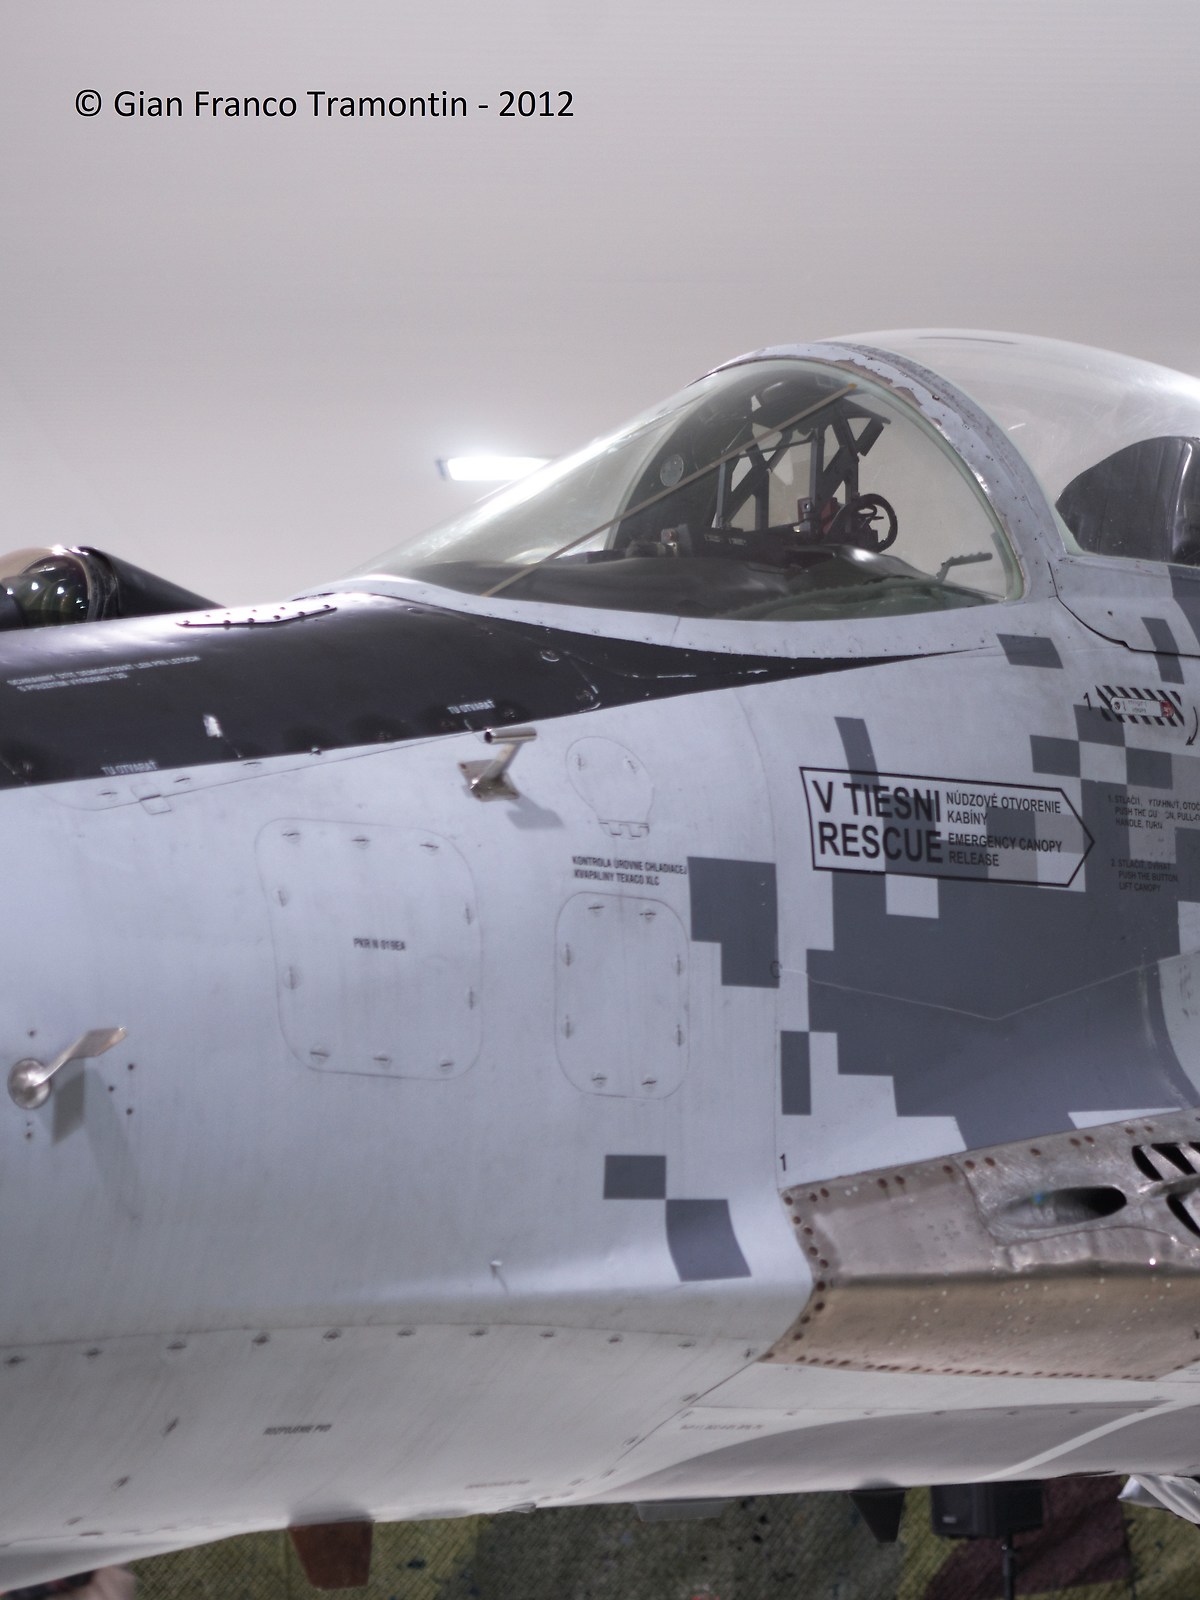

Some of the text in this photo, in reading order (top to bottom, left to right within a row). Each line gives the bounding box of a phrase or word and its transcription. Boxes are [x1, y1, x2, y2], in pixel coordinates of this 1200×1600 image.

[1083, 692, 1091, 710] 1
[812, 780, 941, 823] V TIESNI
[946, 791, 1061, 814] NÚDZOVÉ OTVORENIE
[947, 811, 988, 826] KABÍNY
[818, 821, 943, 864] RESCUE
[948, 832, 1062, 853] EMERGENCY CANOPY
[949, 851, 999, 867] RELEASE
[779, 1152, 786, 1171] 1
